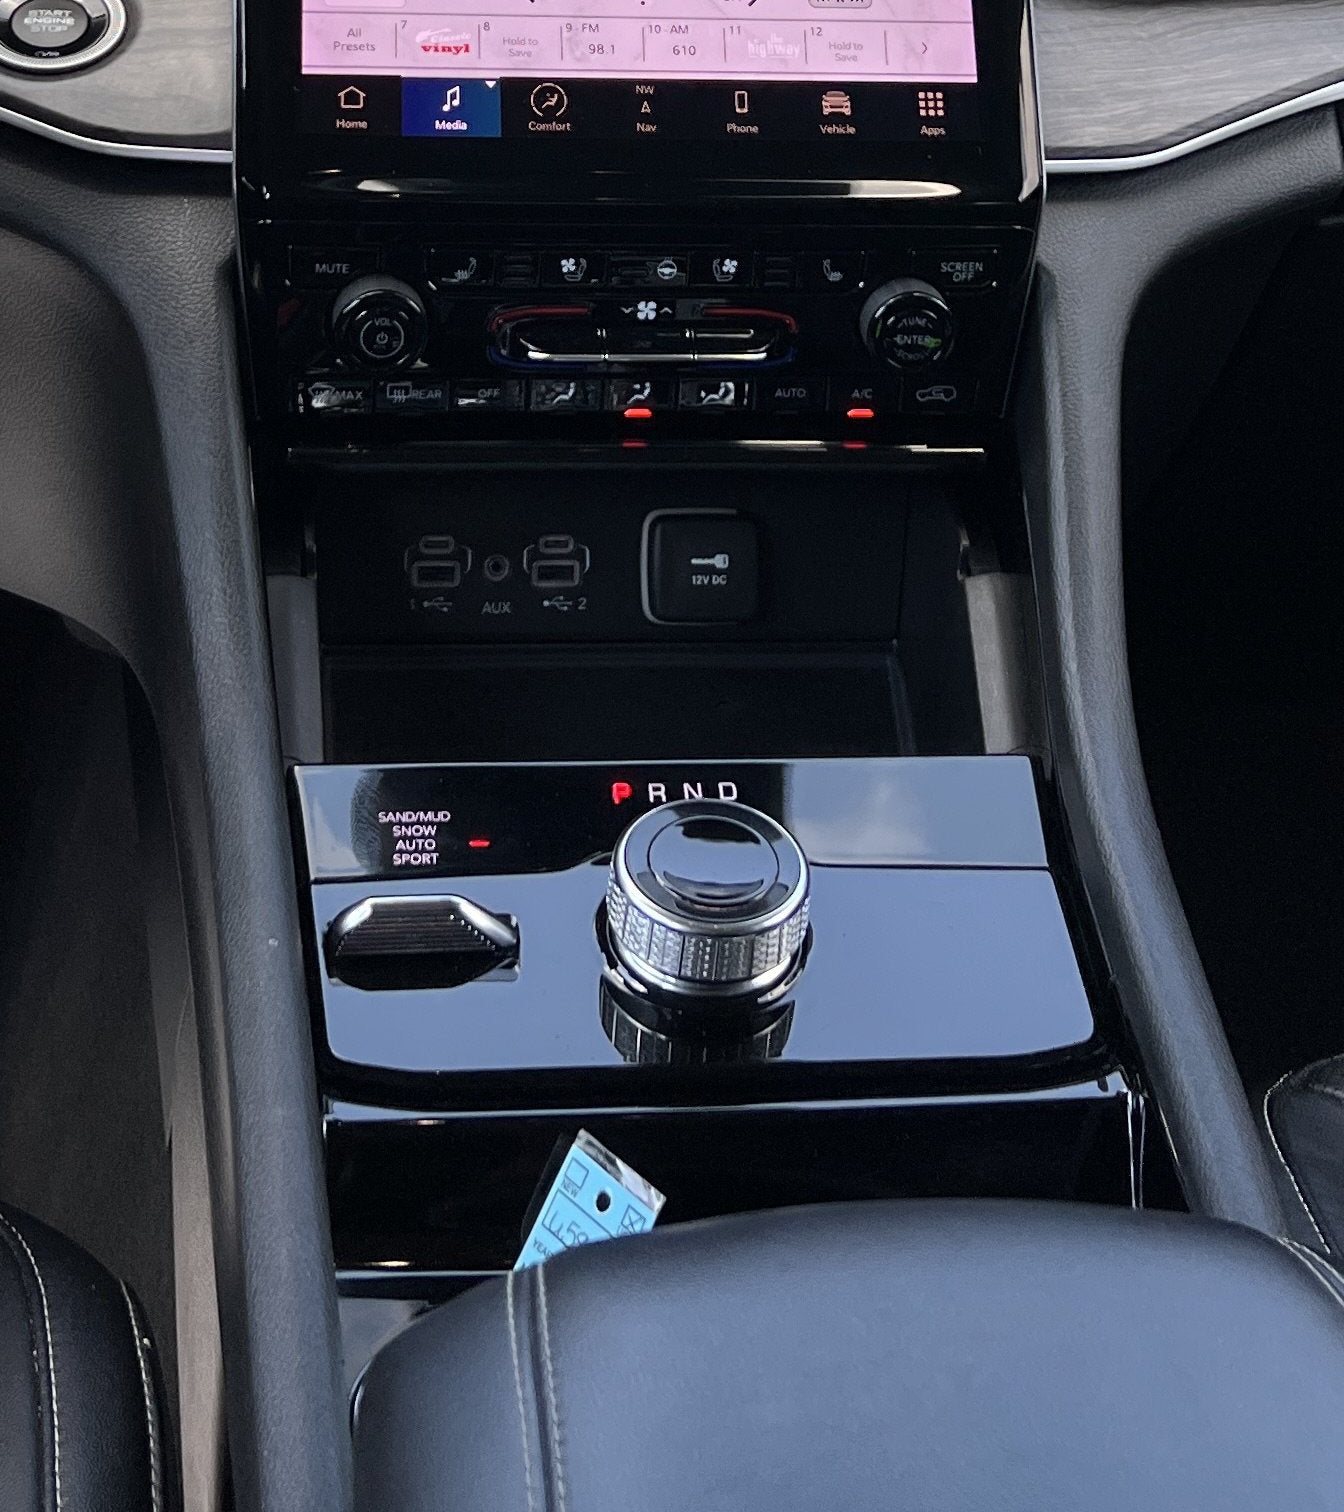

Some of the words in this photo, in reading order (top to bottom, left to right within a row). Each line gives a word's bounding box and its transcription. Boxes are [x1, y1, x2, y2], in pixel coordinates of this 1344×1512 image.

[28, 9, 73, 17] START
[23, 17, 76, 25] ENGINE
[401, 20, 408, 30] 7
[30, 25, 68, 33] STOP
[483, 22, 491, 32] 8
[565, 23, 573, 33] 9
[581, 23, 600, 33] FM
[648, 24, 662, 34] 10
[669, 24, 690, 35] AM
[729, 25, 742, 35] 11
[810, 27, 823, 37] 12
[347, 28, 362, 39] All
[333, 41, 376, 53] Presets
[502, 37, 522, 47] Hold
[525, 37, 539, 47] to
[828, 41, 852, 52] Hold
[854, 42, 864, 52] to
[421, 42, 471, 56] vinyl
[508, 48, 533, 59] Save
[588, 44, 616, 56] 98.1
[672, 45, 697, 56] 610
[747, 40, 802, 59] highway
[834, 52, 858, 63] Save
[635, 85, 655, 95] NW
[336, 119, 368, 130] Home
[435, 119, 468, 131] Media
[528, 120, 571, 133] Comfort
[636, 122, 657, 133] Nav
[726, 123, 759, 134] Phone
[819, 124, 856, 135] Vehicle
[920, 124, 946, 137] Apps
[315, 263, 350, 274] MUTE
[940, 262, 983, 272] SCREEN
[953, 272, 975, 282] OFF
[374, 316, 393, 327] VOL
[903, 317, 928, 328] TUNE
[896, 334, 932, 346] ENTER
[337, 389, 363, 400] MAX
[412, 390, 442, 400] REAR
[478, 388, 500, 399] OFF
[775, 388, 806, 399] AUTO
[852, 389, 873, 399] A/C
[692, 574, 710, 586] 12V
[712, 574, 727, 586] DC
[481, 601, 512, 614] AUX
[577, 598, 587, 610] 2
[612, 782, 633, 804] P
[649, 782, 667, 803] R
[684, 782, 704, 800] N
[718, 781, 739, 801] D
[378, 810, 451, 823] SAND/MUD
[392, 824, 437, 837] SNOW
[395, 838, 436, 852] AUTO
[392, 852, 439, 866] SPORT
